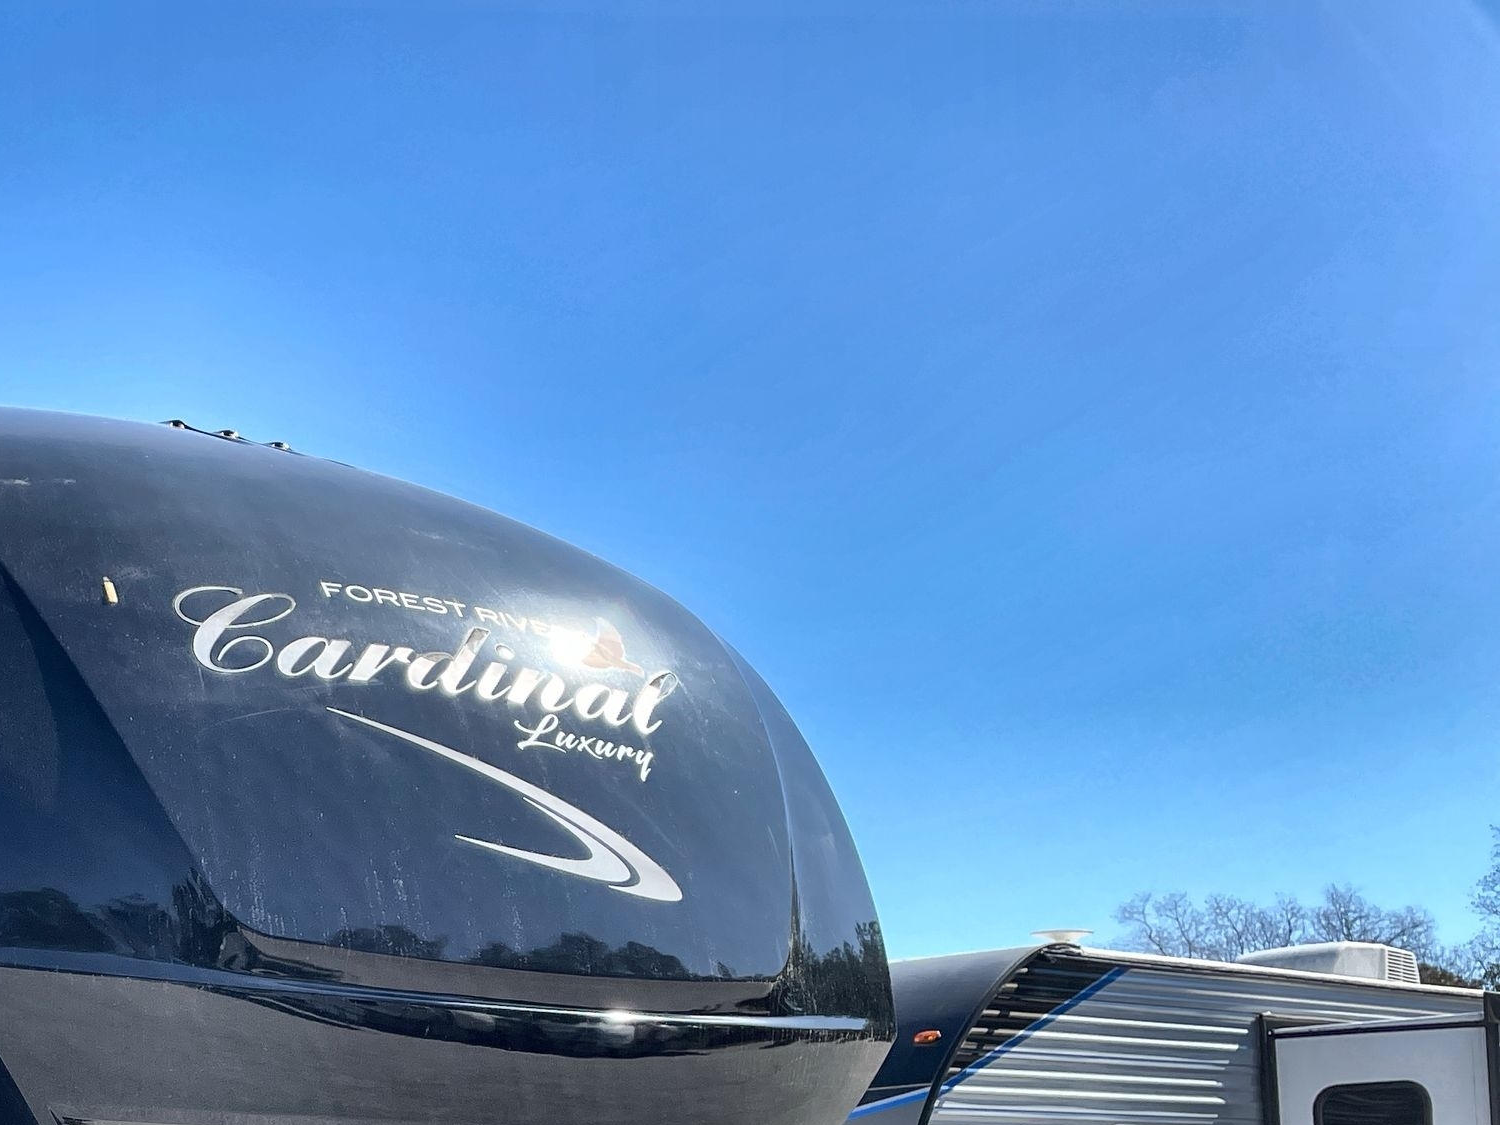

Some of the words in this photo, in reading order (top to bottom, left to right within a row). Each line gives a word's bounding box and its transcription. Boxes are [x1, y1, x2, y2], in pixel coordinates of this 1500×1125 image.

[320, 581, 467, 617] FOREST
[474, 605, 558, 640] RIVE
[173, 585, 679, 735] Cardinal
[513, 713, 654, 783] Luxury
